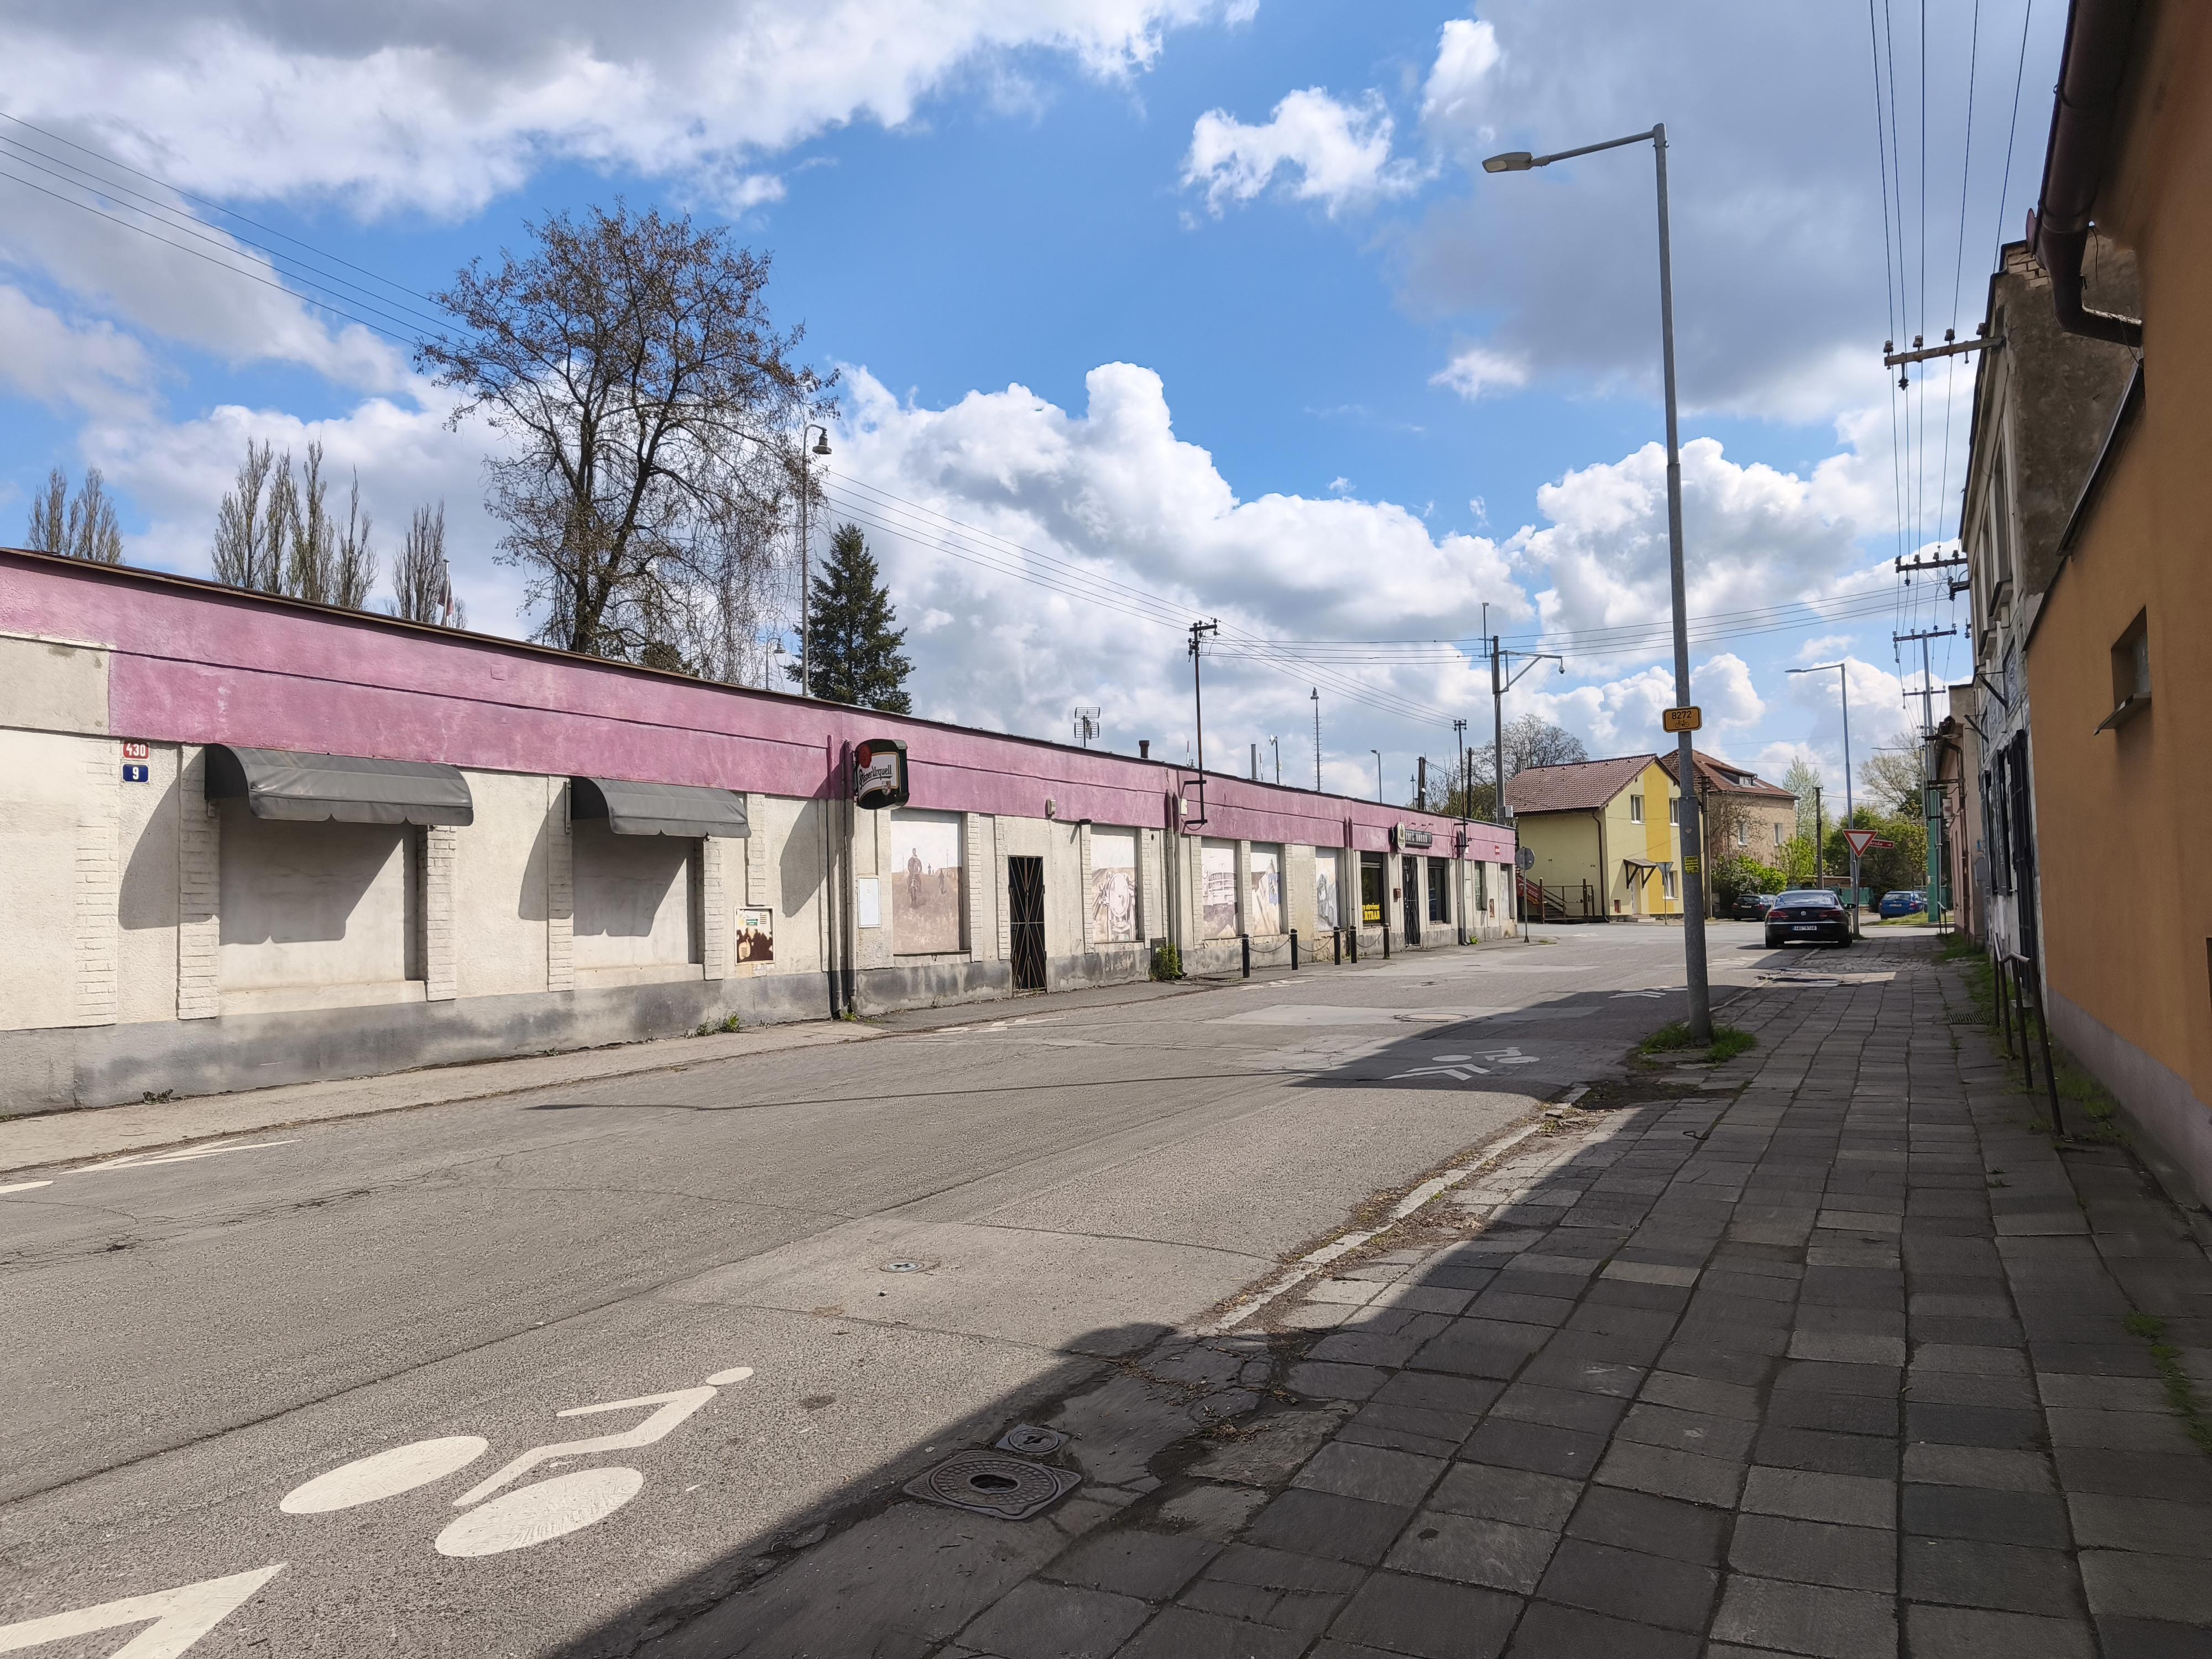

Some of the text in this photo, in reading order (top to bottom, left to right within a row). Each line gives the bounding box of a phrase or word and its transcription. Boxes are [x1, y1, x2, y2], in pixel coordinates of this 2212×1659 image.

[1672, 711, 1692, 719] 8272
[126, 743, 146, 757] 430
[132, 766, 139, 780] 9
[872, 764, 892, 780] Urquell
